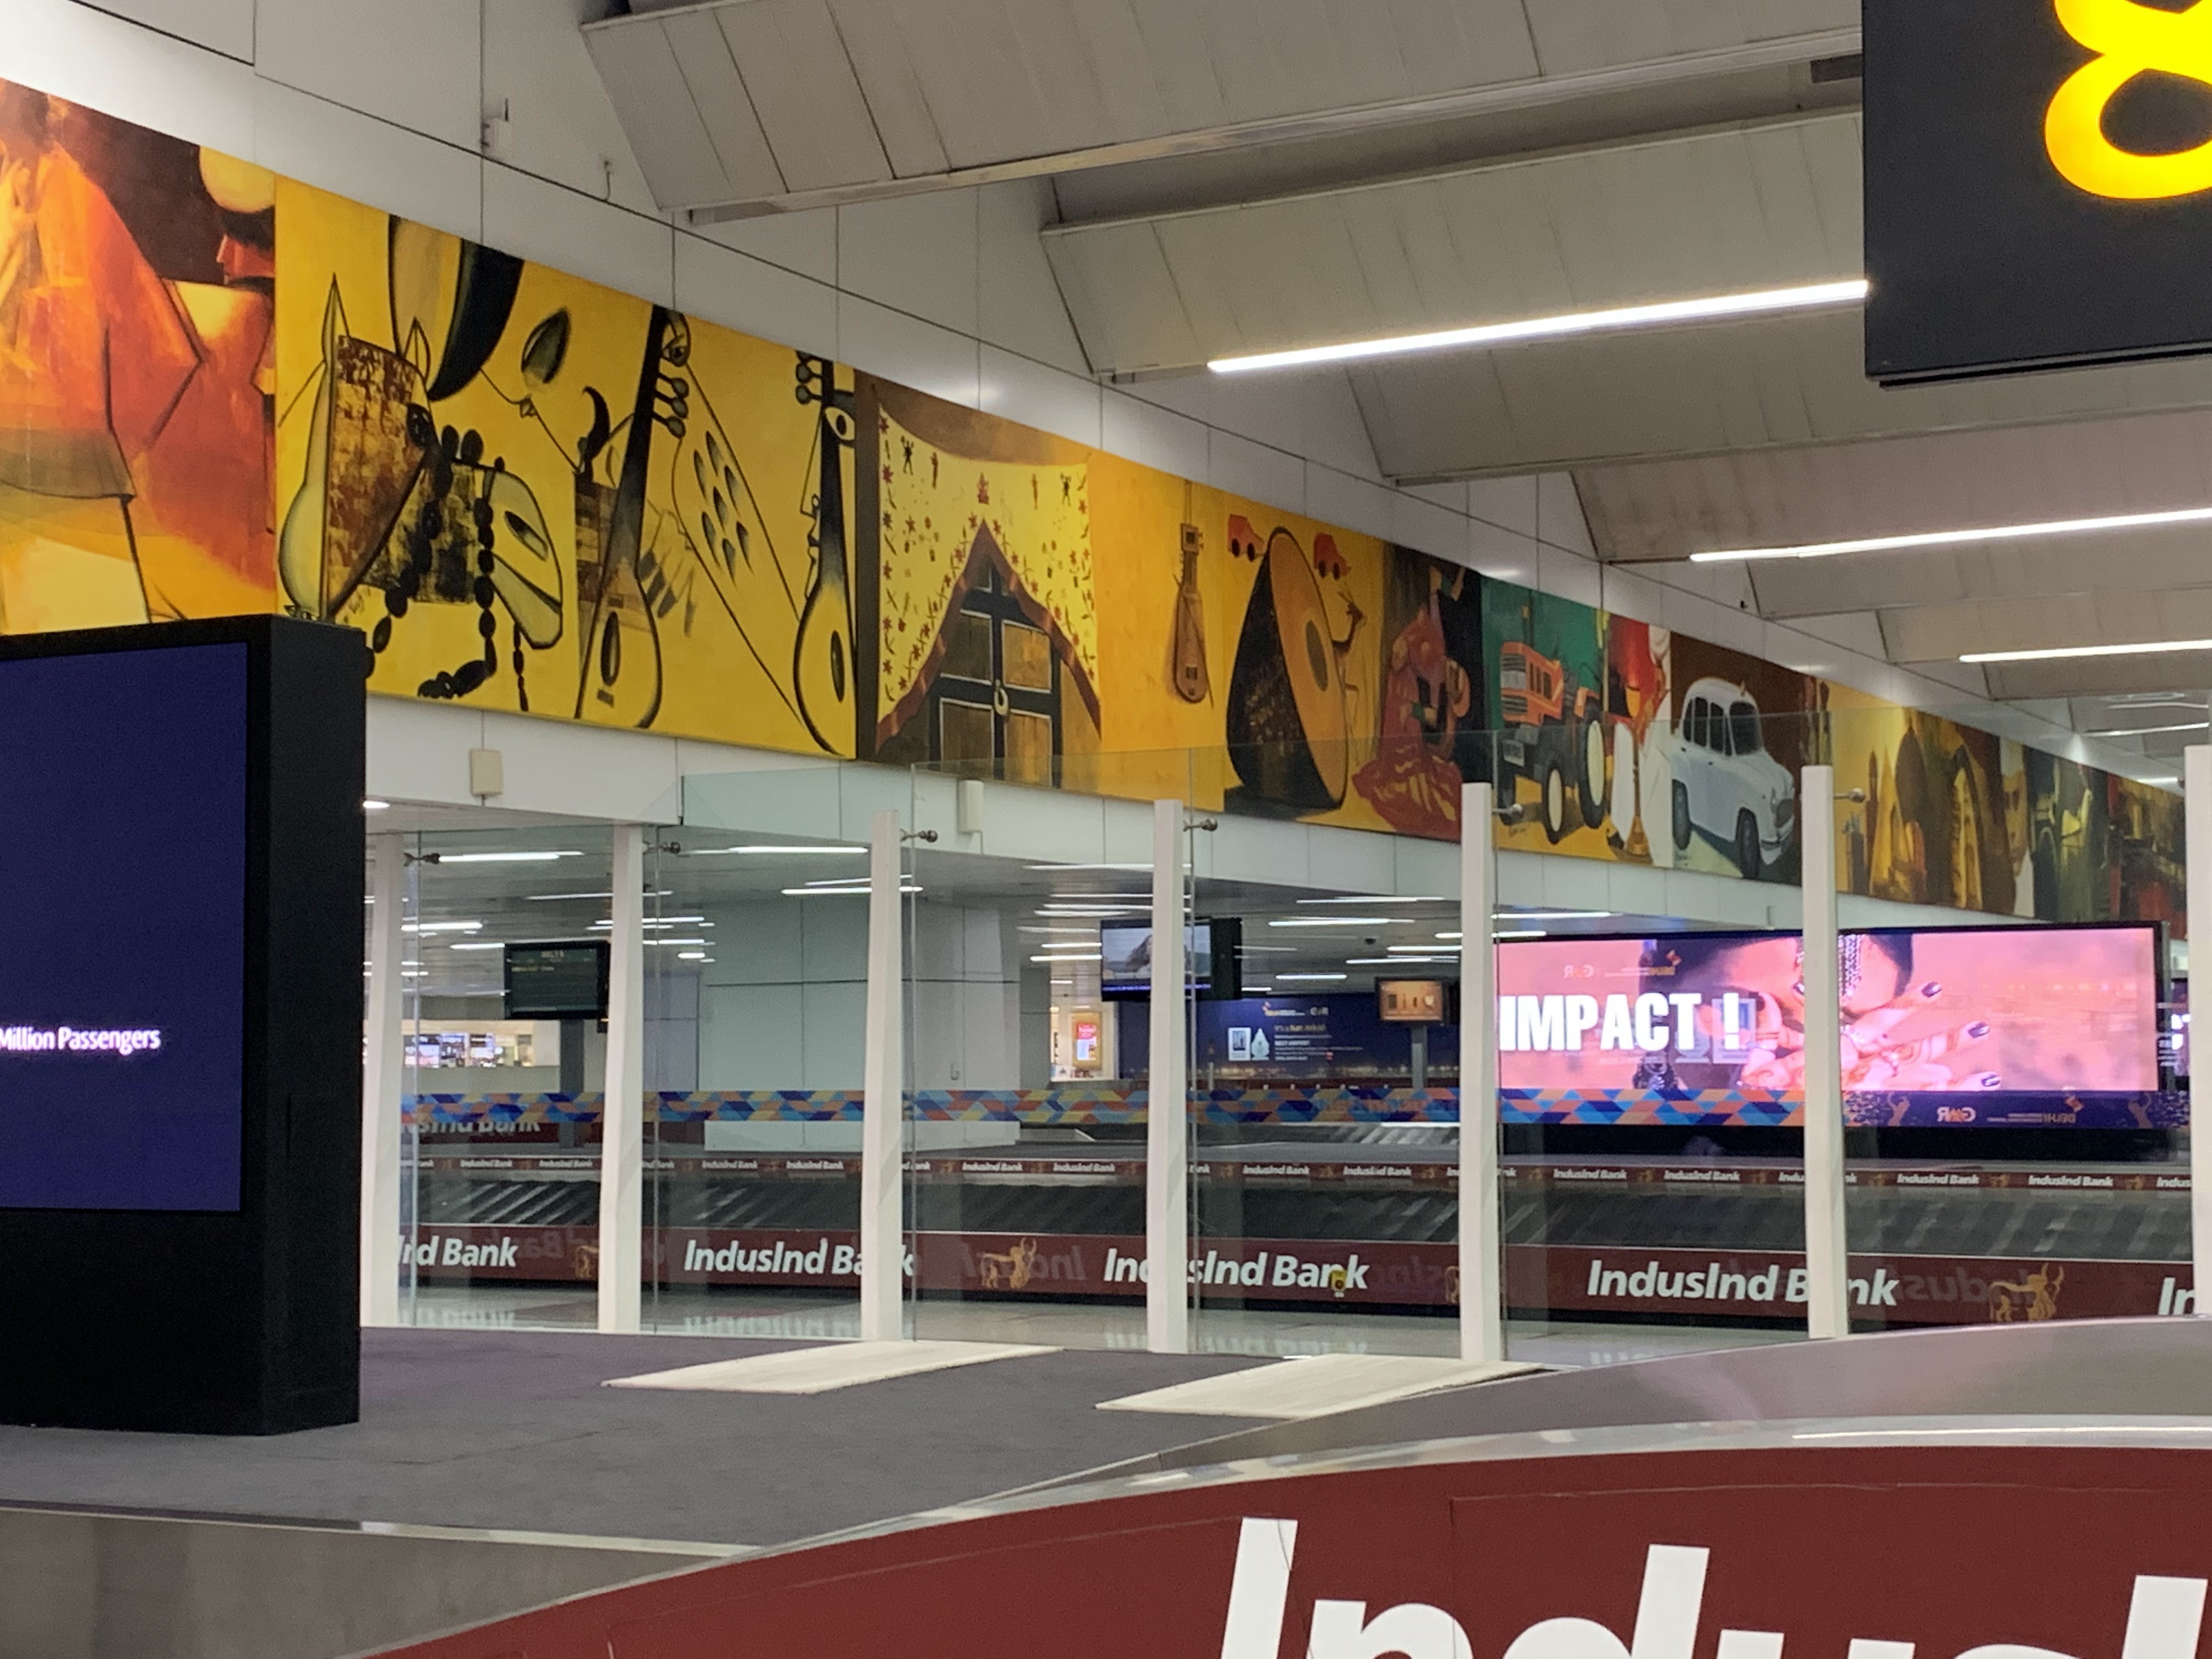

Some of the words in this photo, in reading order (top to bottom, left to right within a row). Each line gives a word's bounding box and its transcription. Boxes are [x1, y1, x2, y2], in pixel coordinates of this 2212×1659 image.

[1499, 993, 1701, 1051] IMPACT
[0, 1027, 55, 1050] Million
[58, 1026, 161, 1056] Passengers
[1713, 1171, 1740, 1181] Bank
[1778, 1172, 1805, 1182] Indu
[1897, 1173, 1949, 1184] IndusInd
[1949, 1174, 1979, 1184] Bank
[2028, 1175, 2082, 1186] IndusInd
[2083, 1176, 2113, 1187] Bank
[2157, 1177, 2192, 1188] Indus
[442, 1237, 518, 1267] Bank
[684, 1238, 828, 1274] IndusInd
[832, 1244, 915, 1277] Bk
[1104, 1248, 1268, 1286] InsInd
[1272, 1254, 1370, 1289] Bank
[1588, 1260, 1779, 1301] IndusInd
[1785, 1268, 1899, 1306] Bnk
